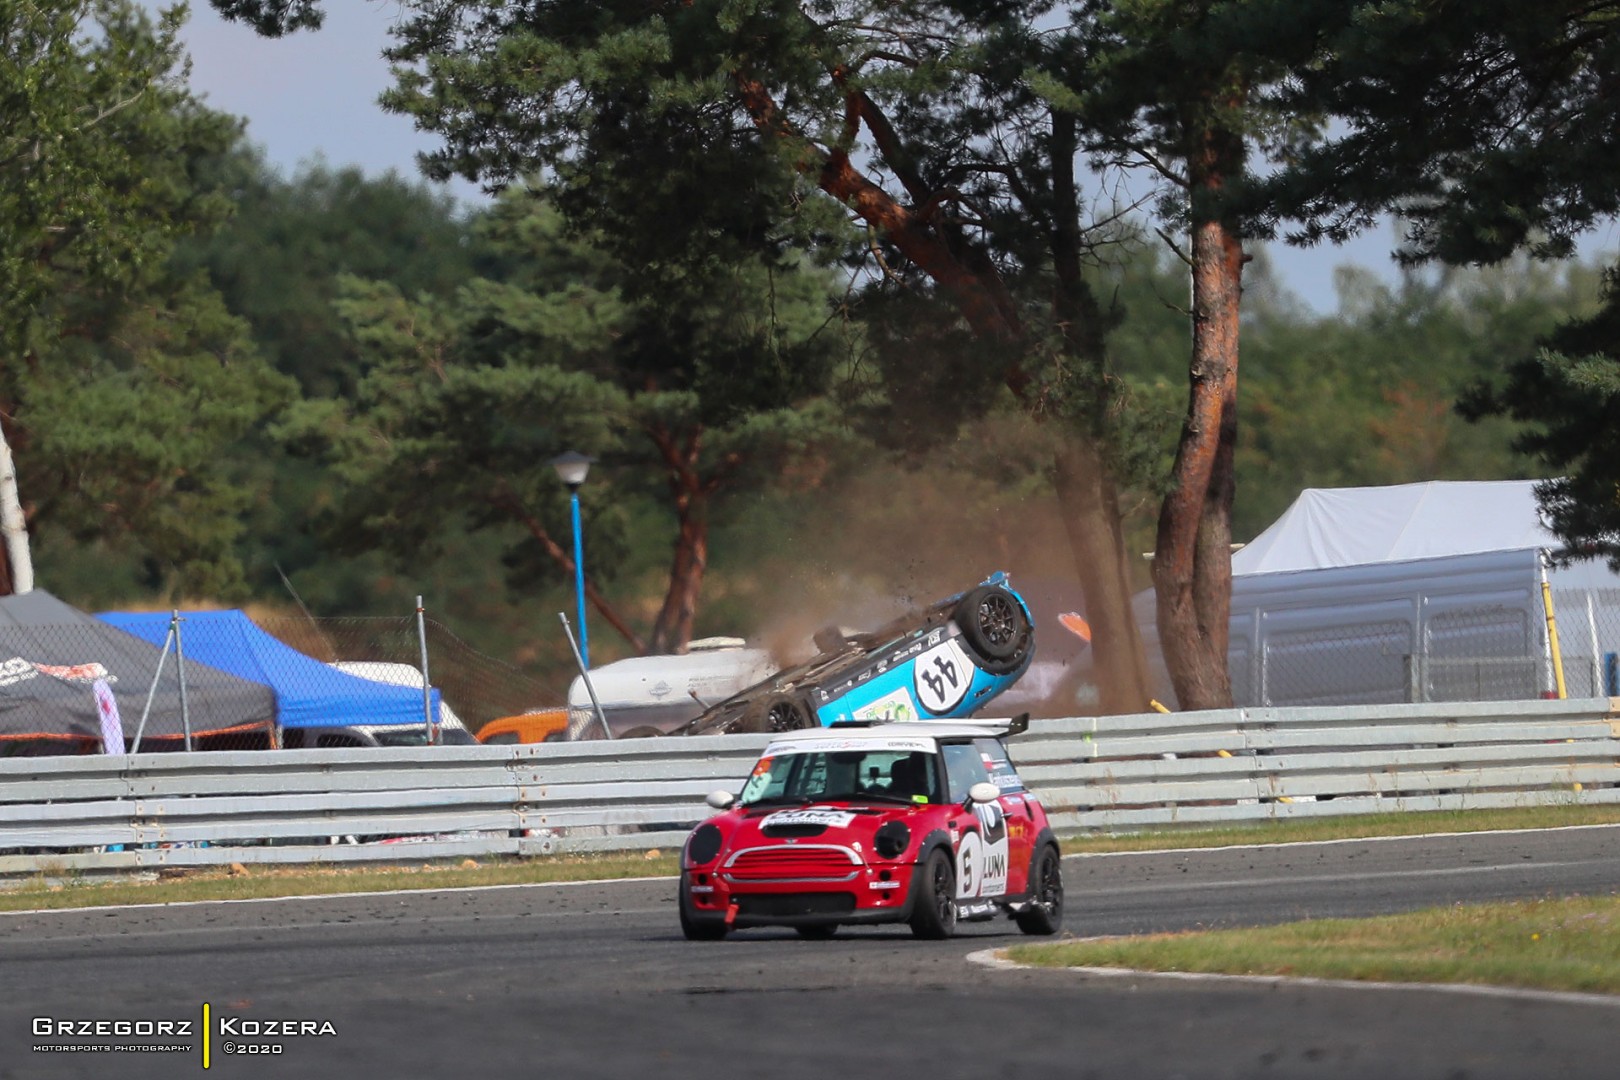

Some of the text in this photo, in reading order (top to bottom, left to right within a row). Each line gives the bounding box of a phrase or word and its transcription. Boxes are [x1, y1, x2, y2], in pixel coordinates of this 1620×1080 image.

[922, 656, 958, 704] 44
[963, 847, 972, 893] 5
[983, 853, 1006, 878] LUNA
